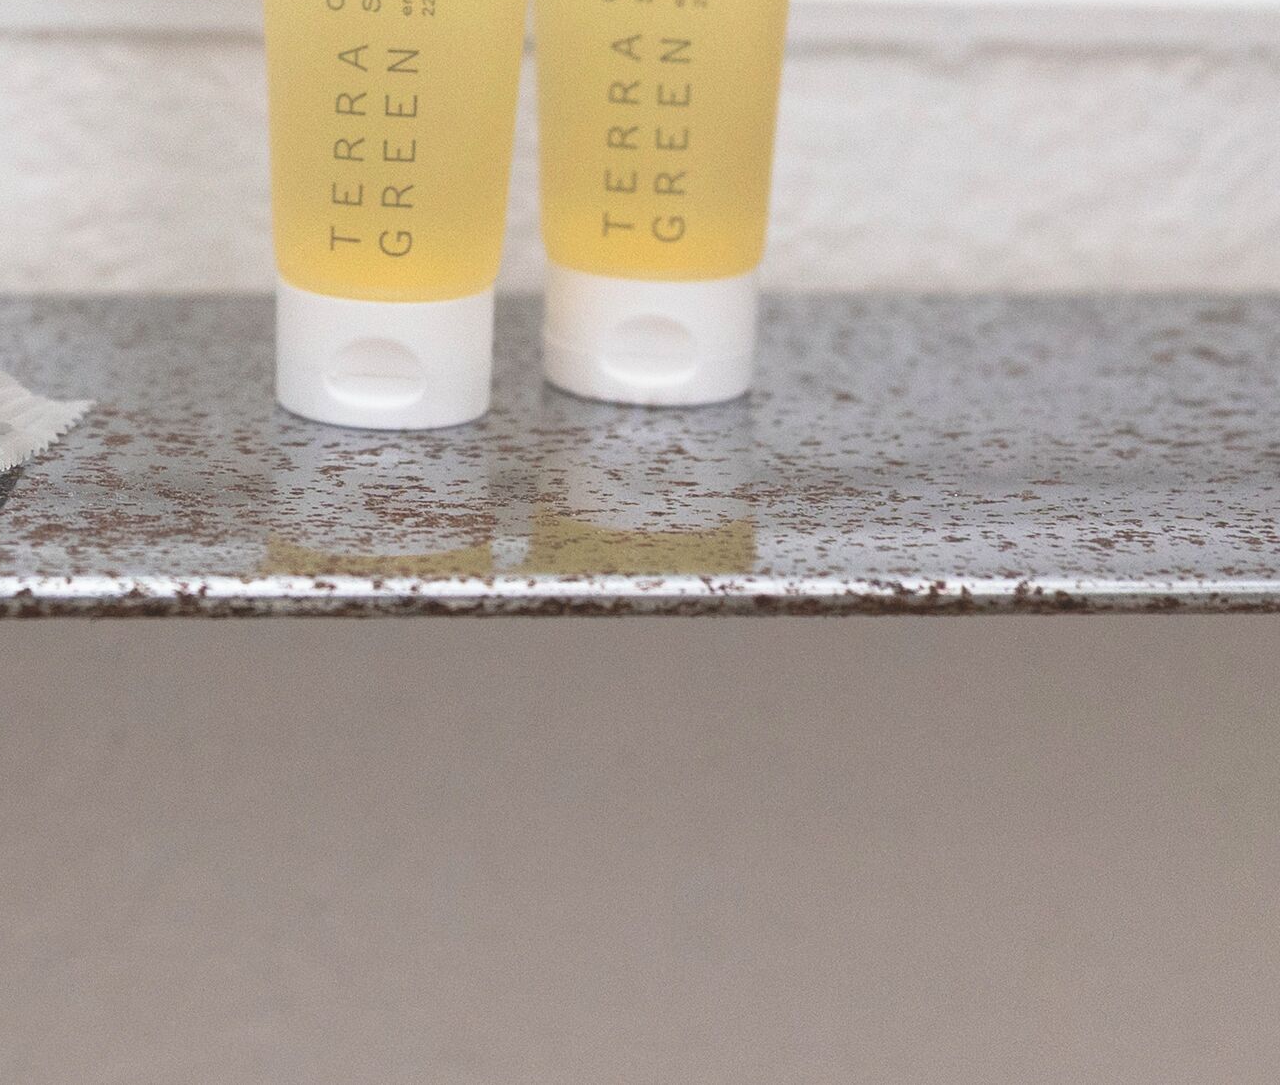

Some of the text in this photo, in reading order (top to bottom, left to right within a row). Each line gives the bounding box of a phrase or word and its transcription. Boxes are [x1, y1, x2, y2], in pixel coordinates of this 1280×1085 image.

[329, 43, 369, 252] TERRA
[378, 47, 421, 258] GREEN
[601, 33, 642, 238] TERRA
[651, 36, 693, 244] GREEN
